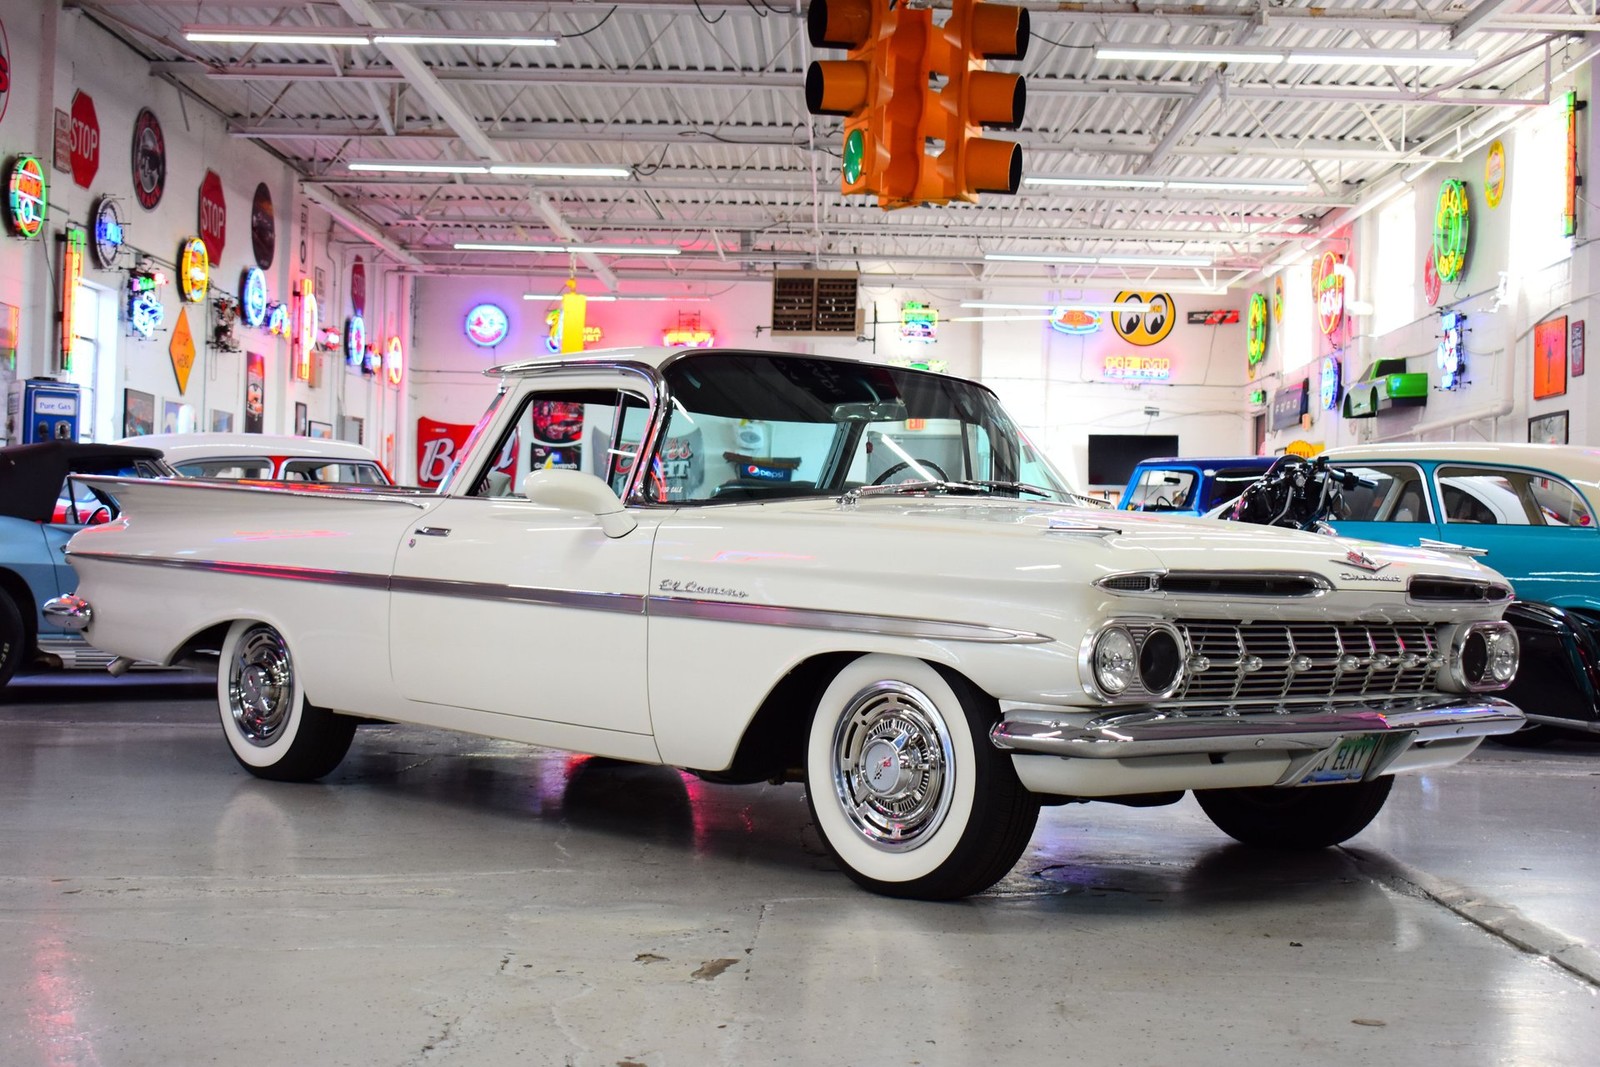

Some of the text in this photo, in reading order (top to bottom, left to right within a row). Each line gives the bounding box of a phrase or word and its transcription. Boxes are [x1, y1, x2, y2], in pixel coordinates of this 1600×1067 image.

[70, 117, 98, 162] STOP
[201, 196, 225, 239] STOP
[39, 401, 72, 411] Pure Gas
[1331, 744, 1369, 771] ELKY
